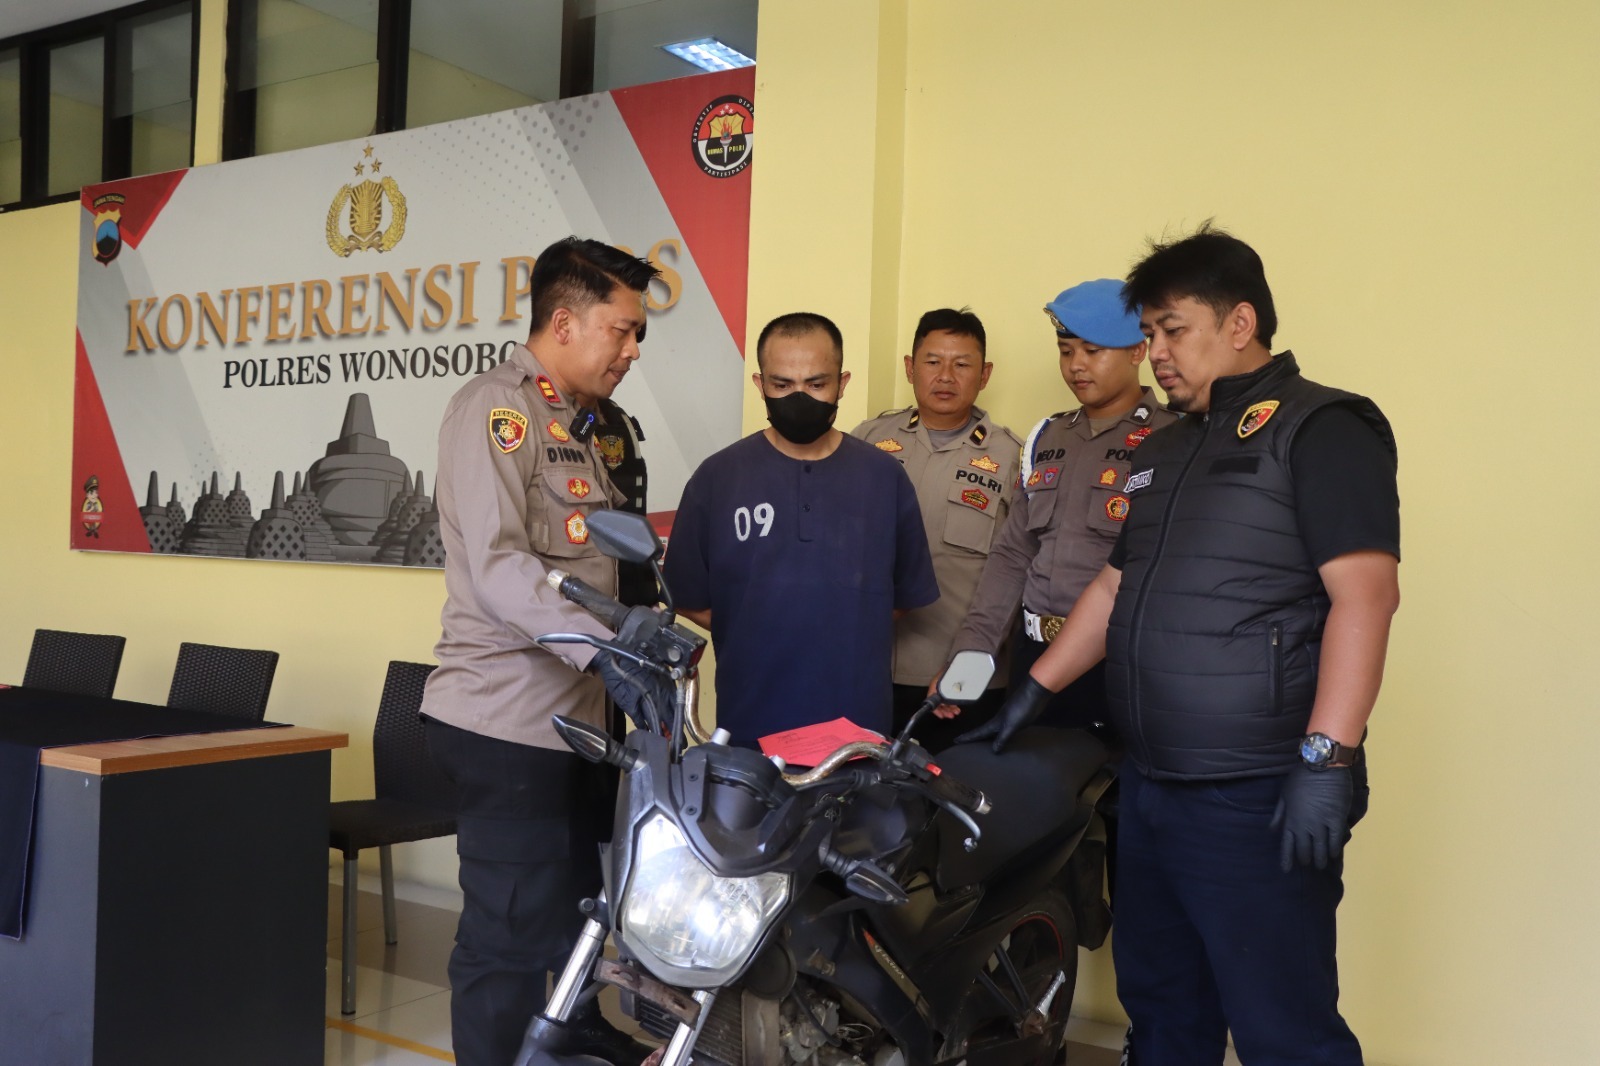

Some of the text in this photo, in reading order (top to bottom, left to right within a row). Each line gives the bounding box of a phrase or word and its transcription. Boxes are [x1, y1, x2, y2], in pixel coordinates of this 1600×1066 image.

[704, 161, 747, 177] PARTISIPASI
[125, 261, 480, 352] KONFERENSI
[223, 353, 331, 389] POLRES
[955, 469, 1002, 494] POLRI
[734, 501, 775, 542] 09
